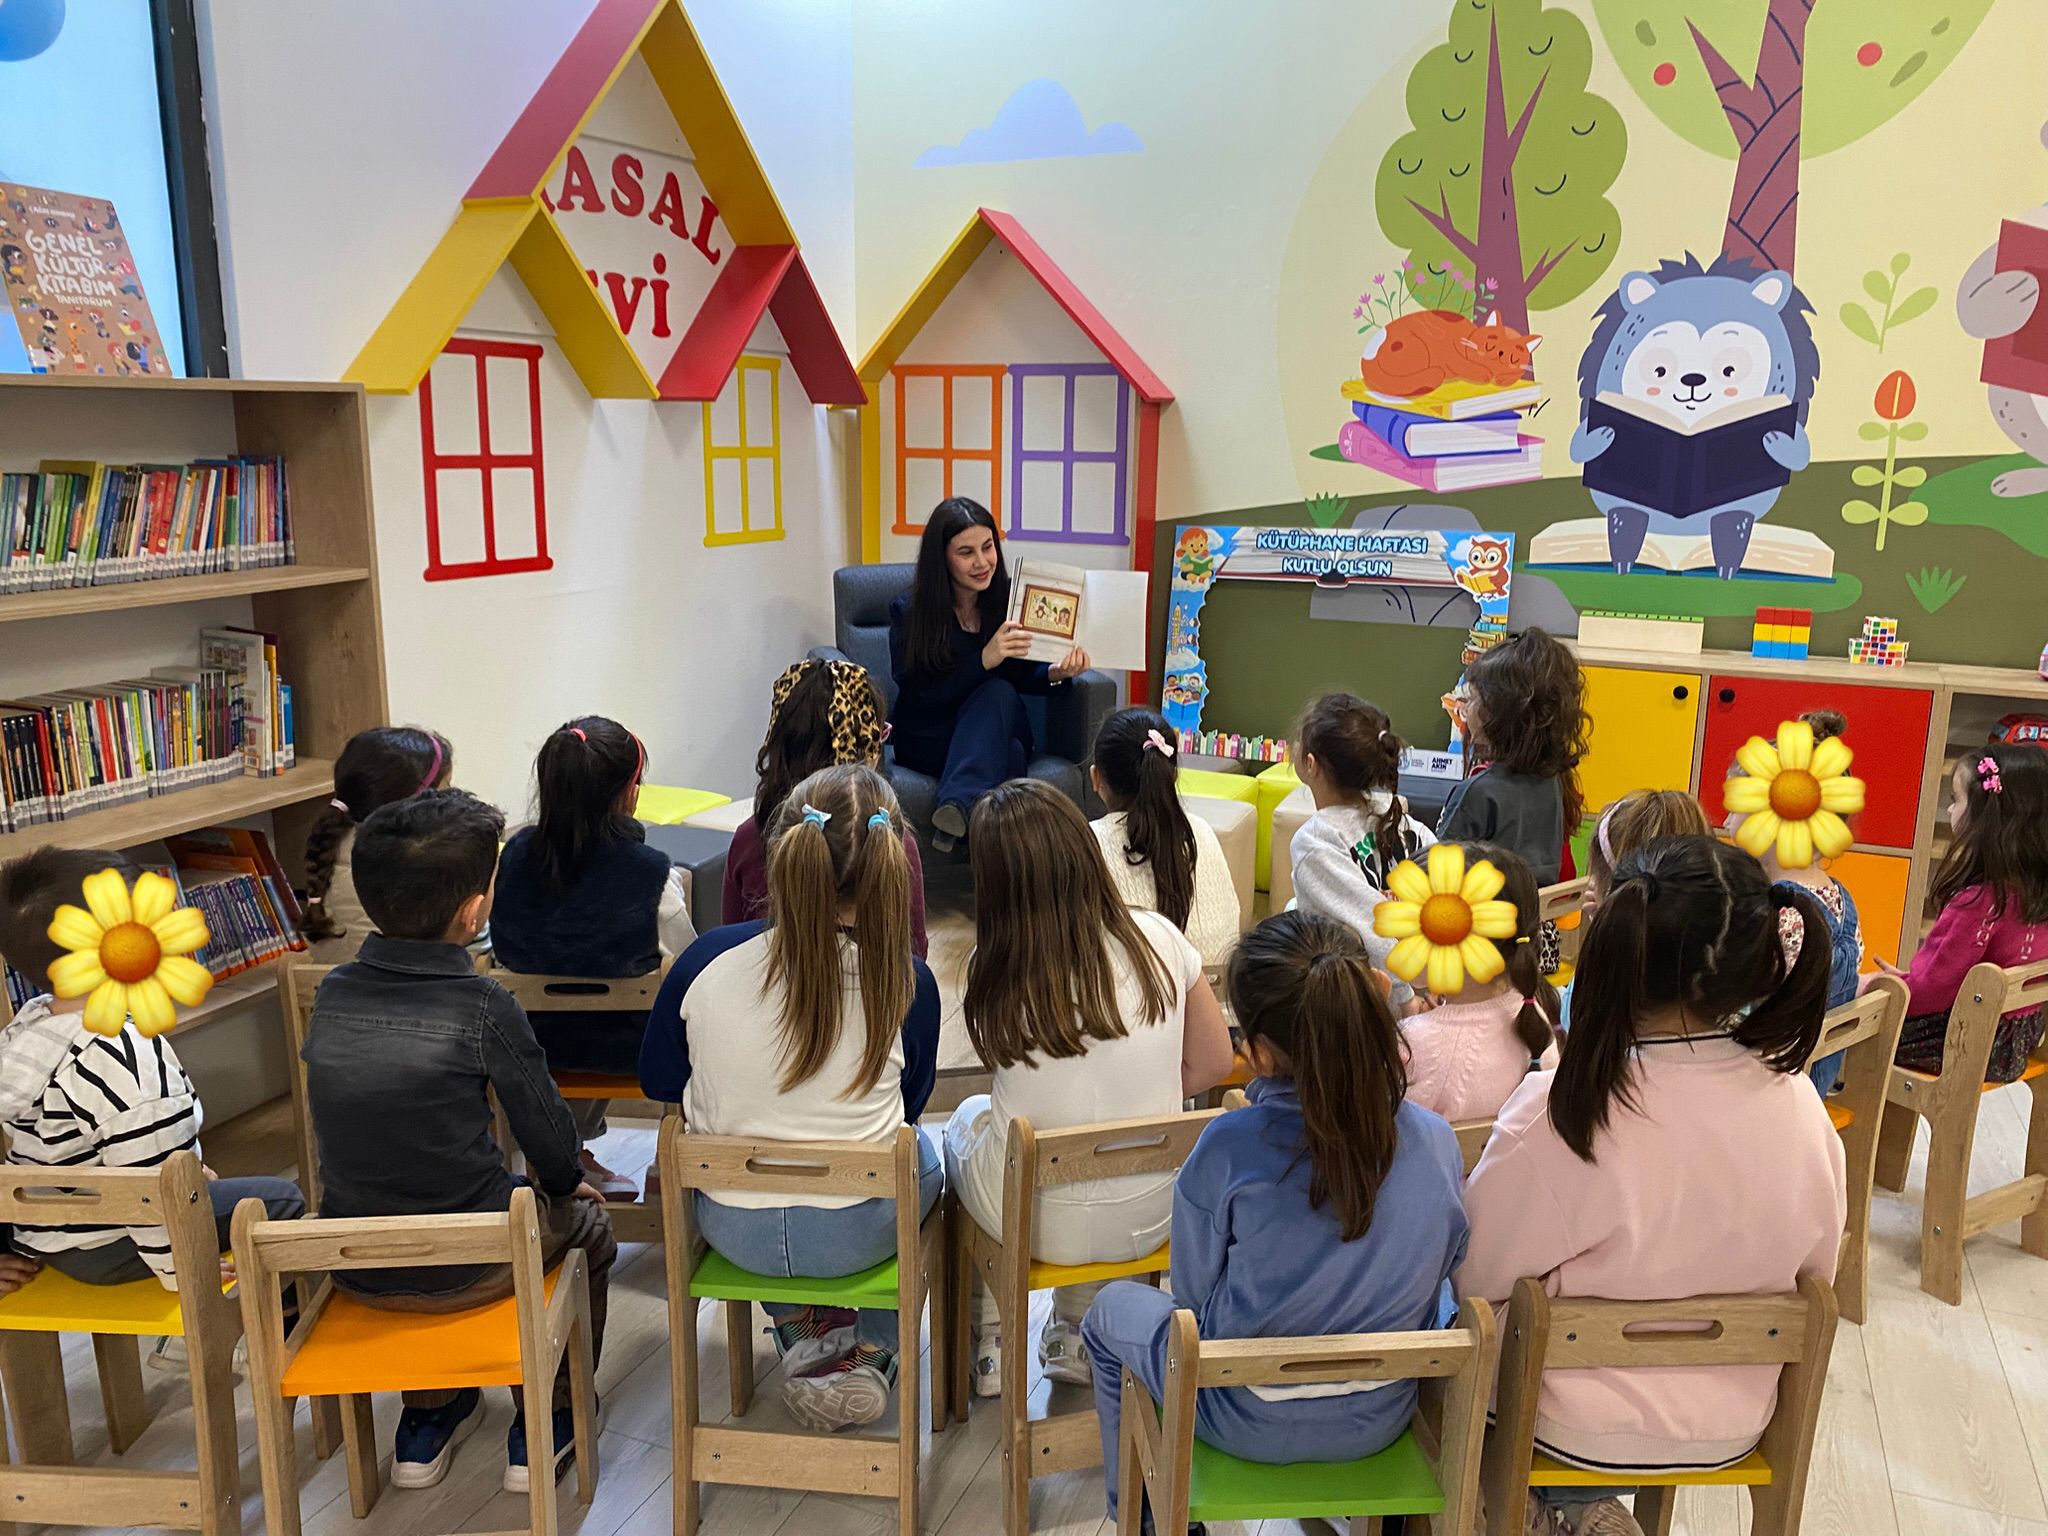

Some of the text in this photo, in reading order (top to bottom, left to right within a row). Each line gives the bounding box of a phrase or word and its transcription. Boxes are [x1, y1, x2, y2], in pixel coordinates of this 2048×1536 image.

[540, 145, 721, 266] ASAL
[25, 229, 103, 257] GENEL
[33, 253, 106, 278] KÜLTÜR
[36, 273, 116, 296] KİTABIM
[585, 253, 671, 338] Vİ
[1256, 530, 1428, 554] KÜTÜPHANE HAFTASI
[1282, 557, 1392, 576] KUTLU OLSUN
